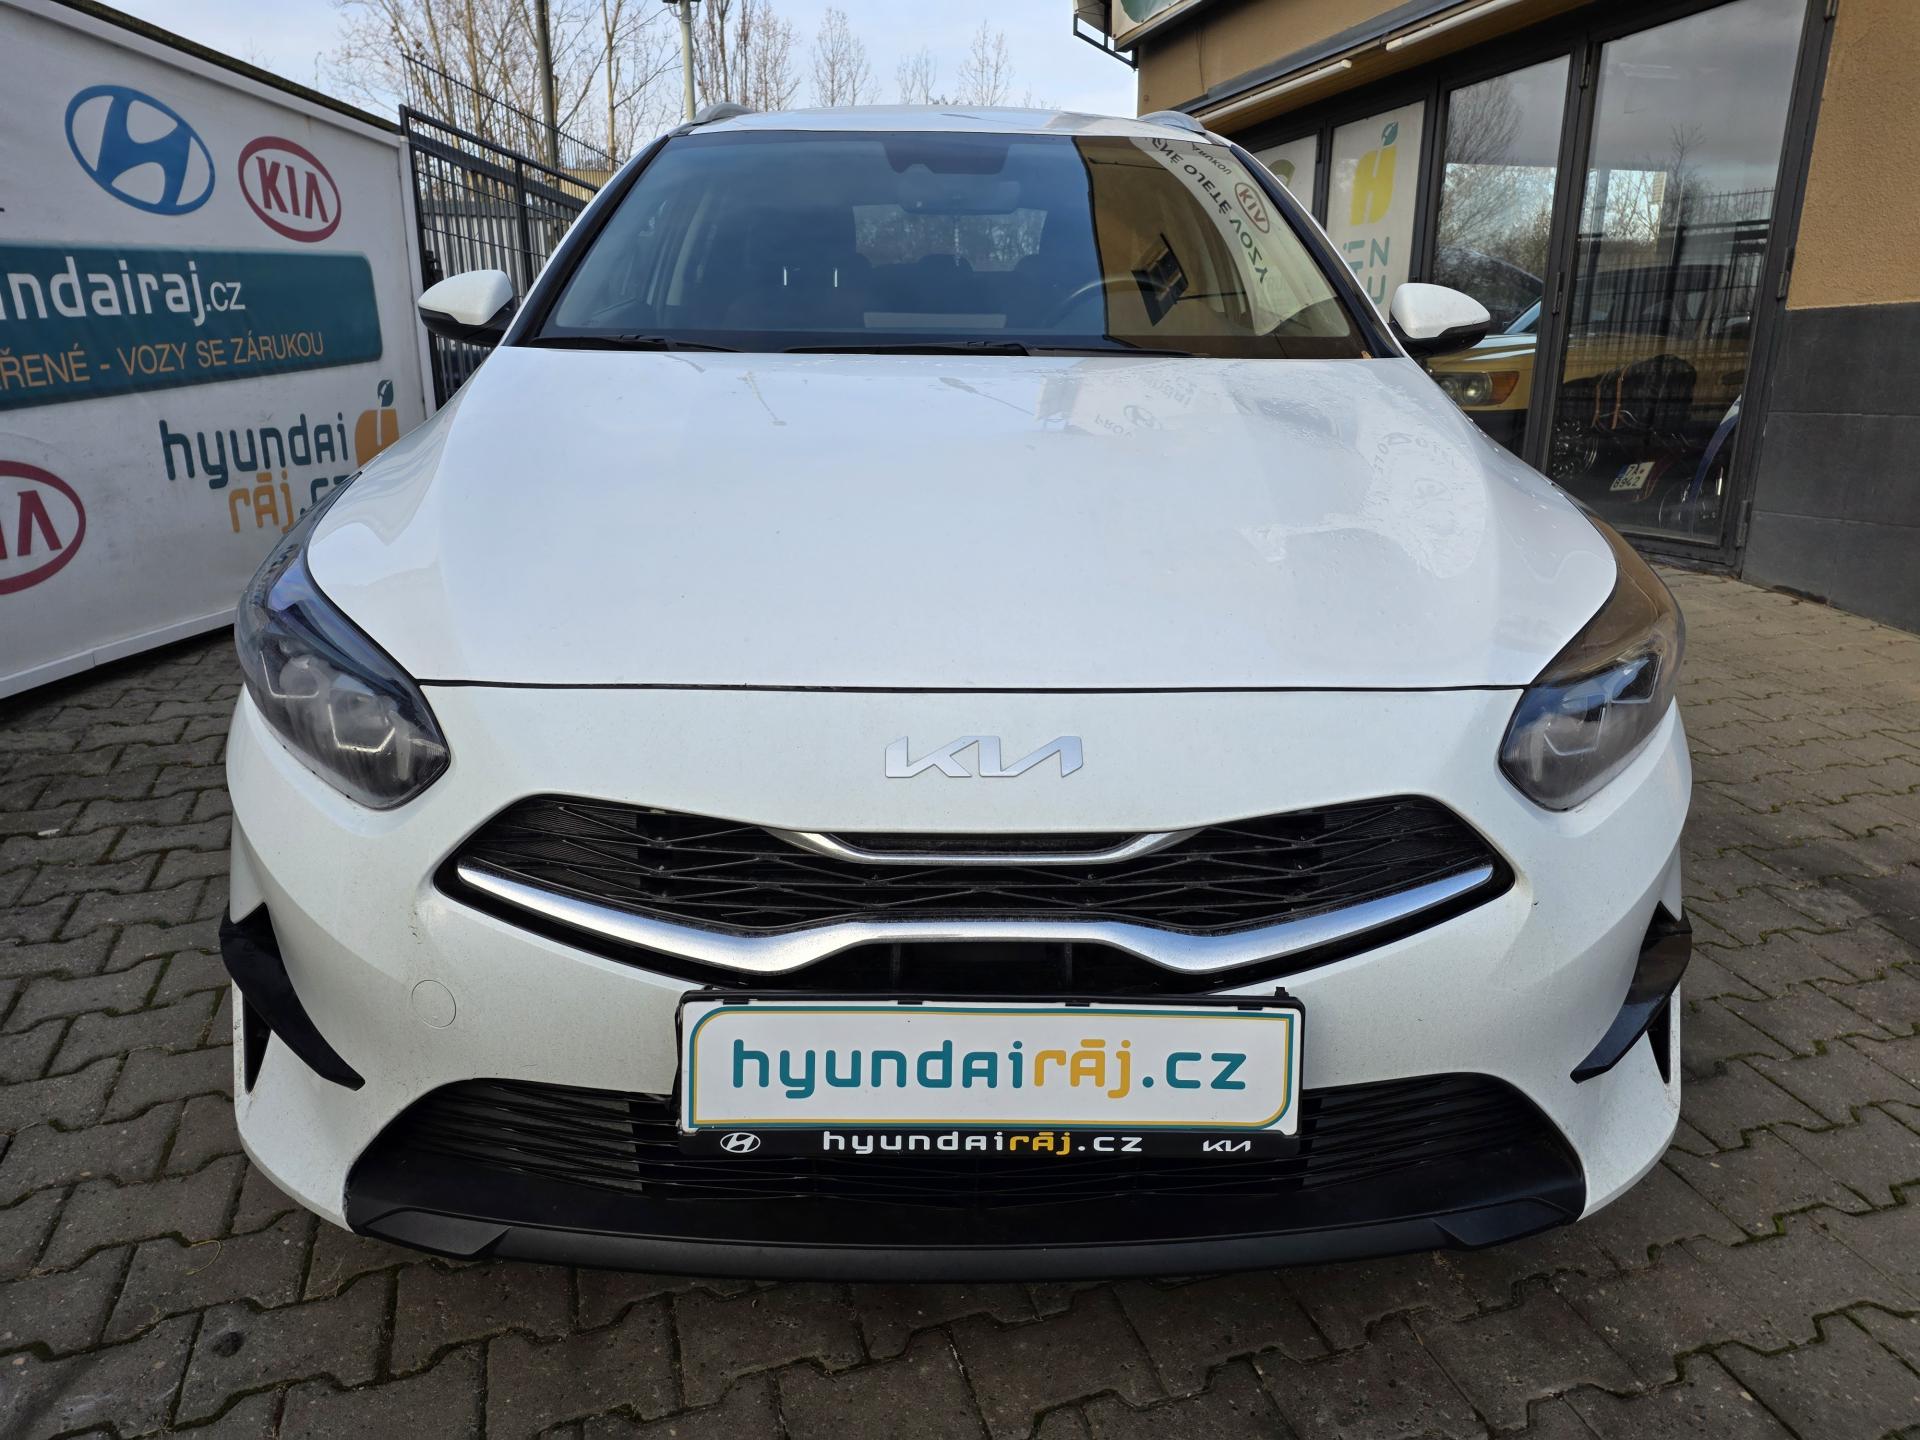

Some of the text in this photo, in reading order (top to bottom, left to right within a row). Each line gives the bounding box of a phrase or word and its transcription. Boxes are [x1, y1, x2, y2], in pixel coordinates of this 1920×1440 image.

[256, 156, 329, 223] KIA
[0, 256, 246, 327] ndairaj.cz
[0, 343, 90, 390] ŘENÉ
[117, 342, 187, 376] VOZY
[195, 338, 228, 369] SE
[230, 330, 324, 365] ZÁRUKOU
[159, 412, 349, 489] hyundai
[885, 735, 1084, 779] KIA
[1202, 1138, 1251, 1153] KIA
